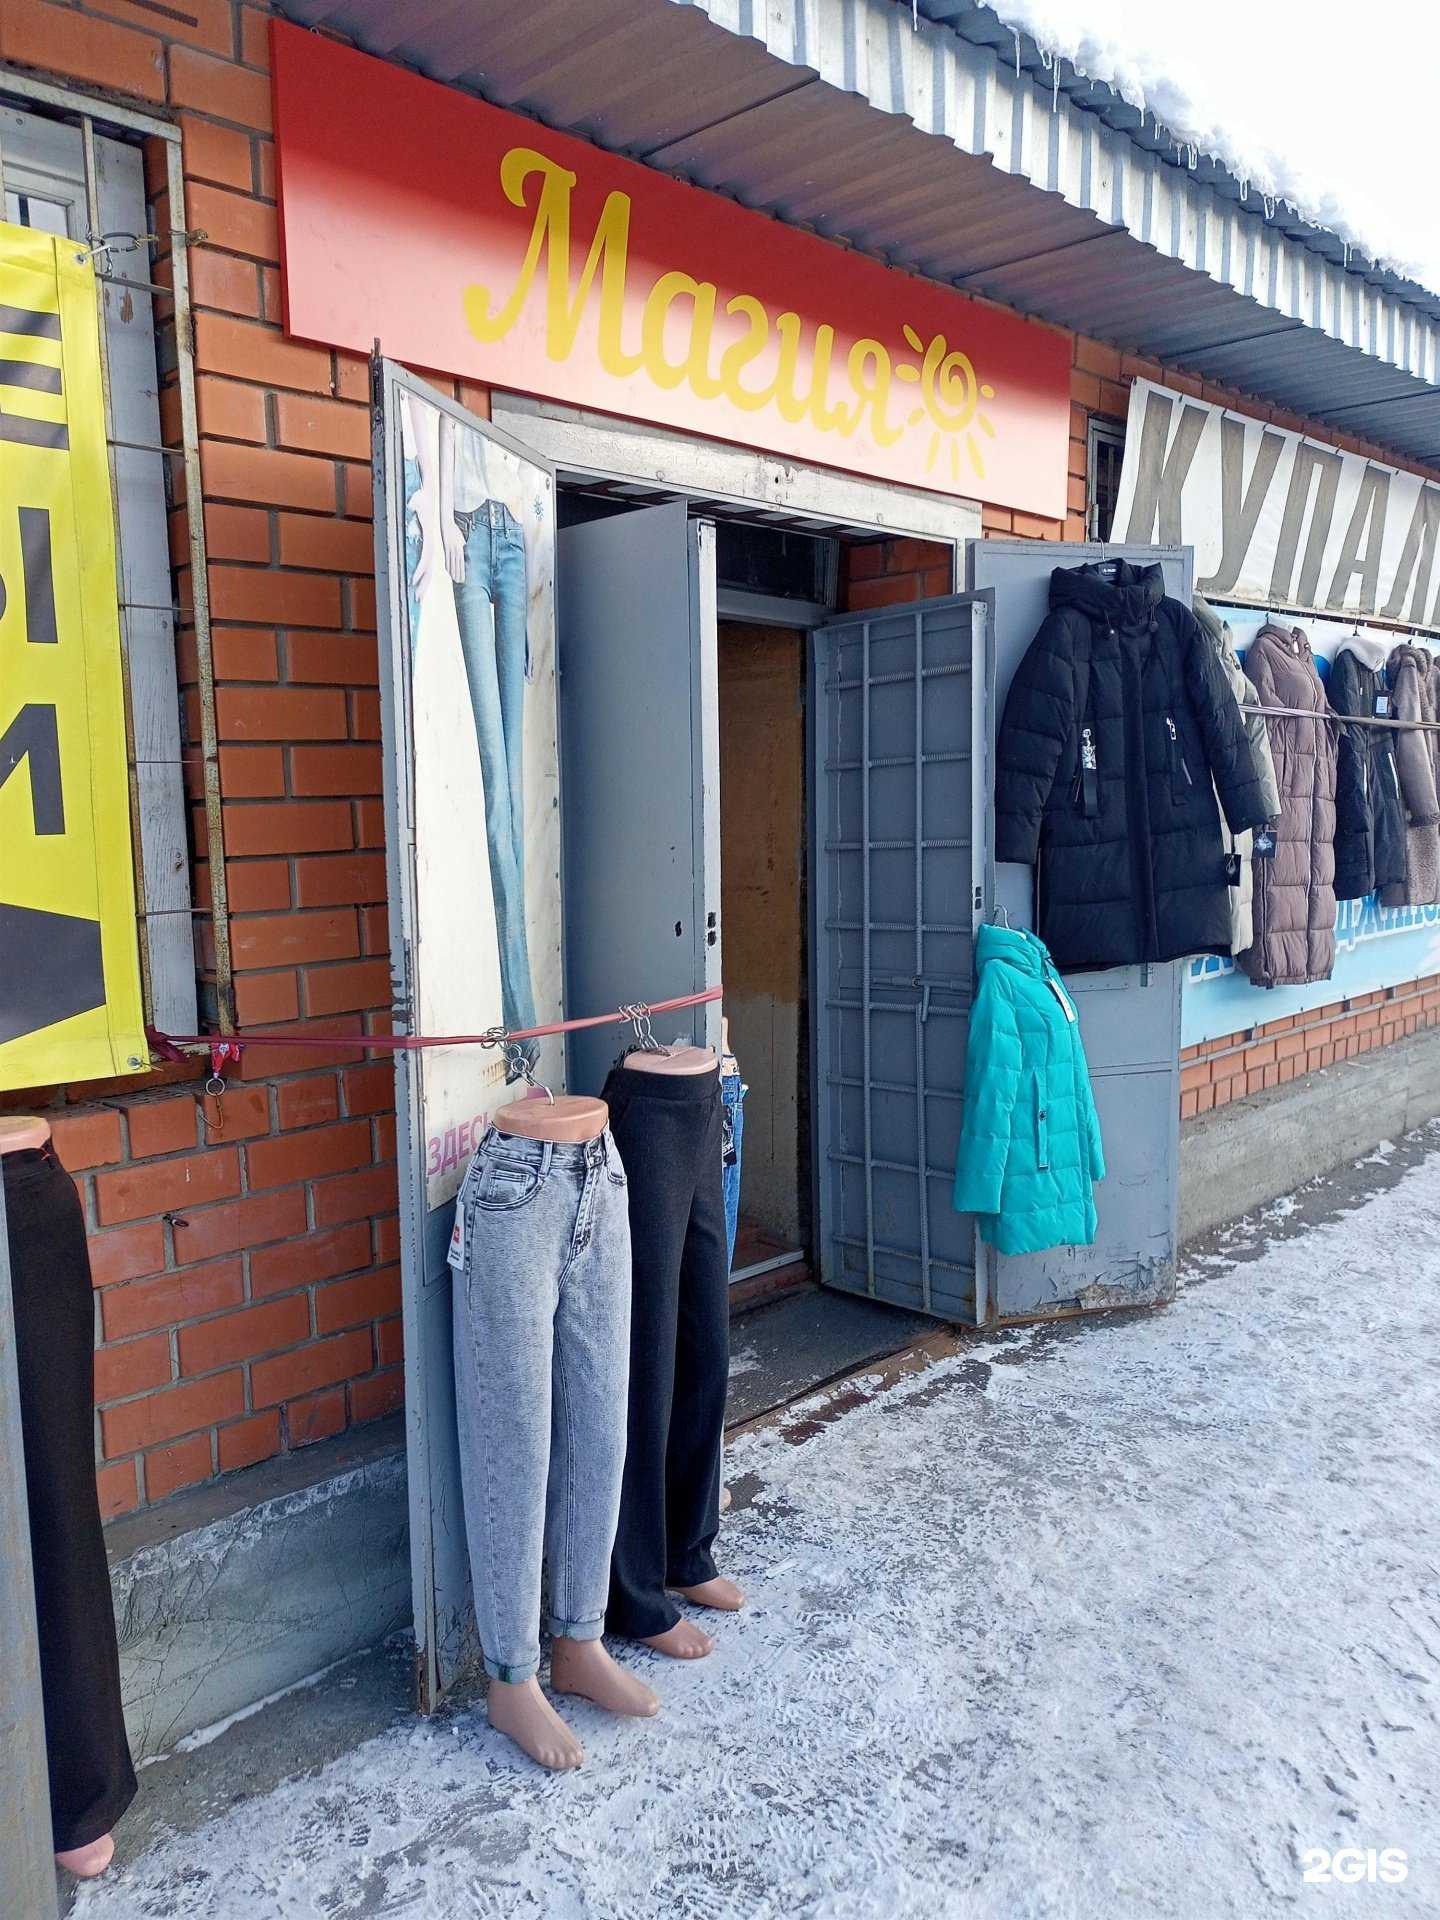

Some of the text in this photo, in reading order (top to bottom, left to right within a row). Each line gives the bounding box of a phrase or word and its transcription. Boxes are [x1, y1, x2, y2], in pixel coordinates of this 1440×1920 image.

[462, 147, 904, 447] Магия
[1125, 390, 1440, 628] КУПАЛ
[427, 1111, 489, 1177] ЗДЕС
